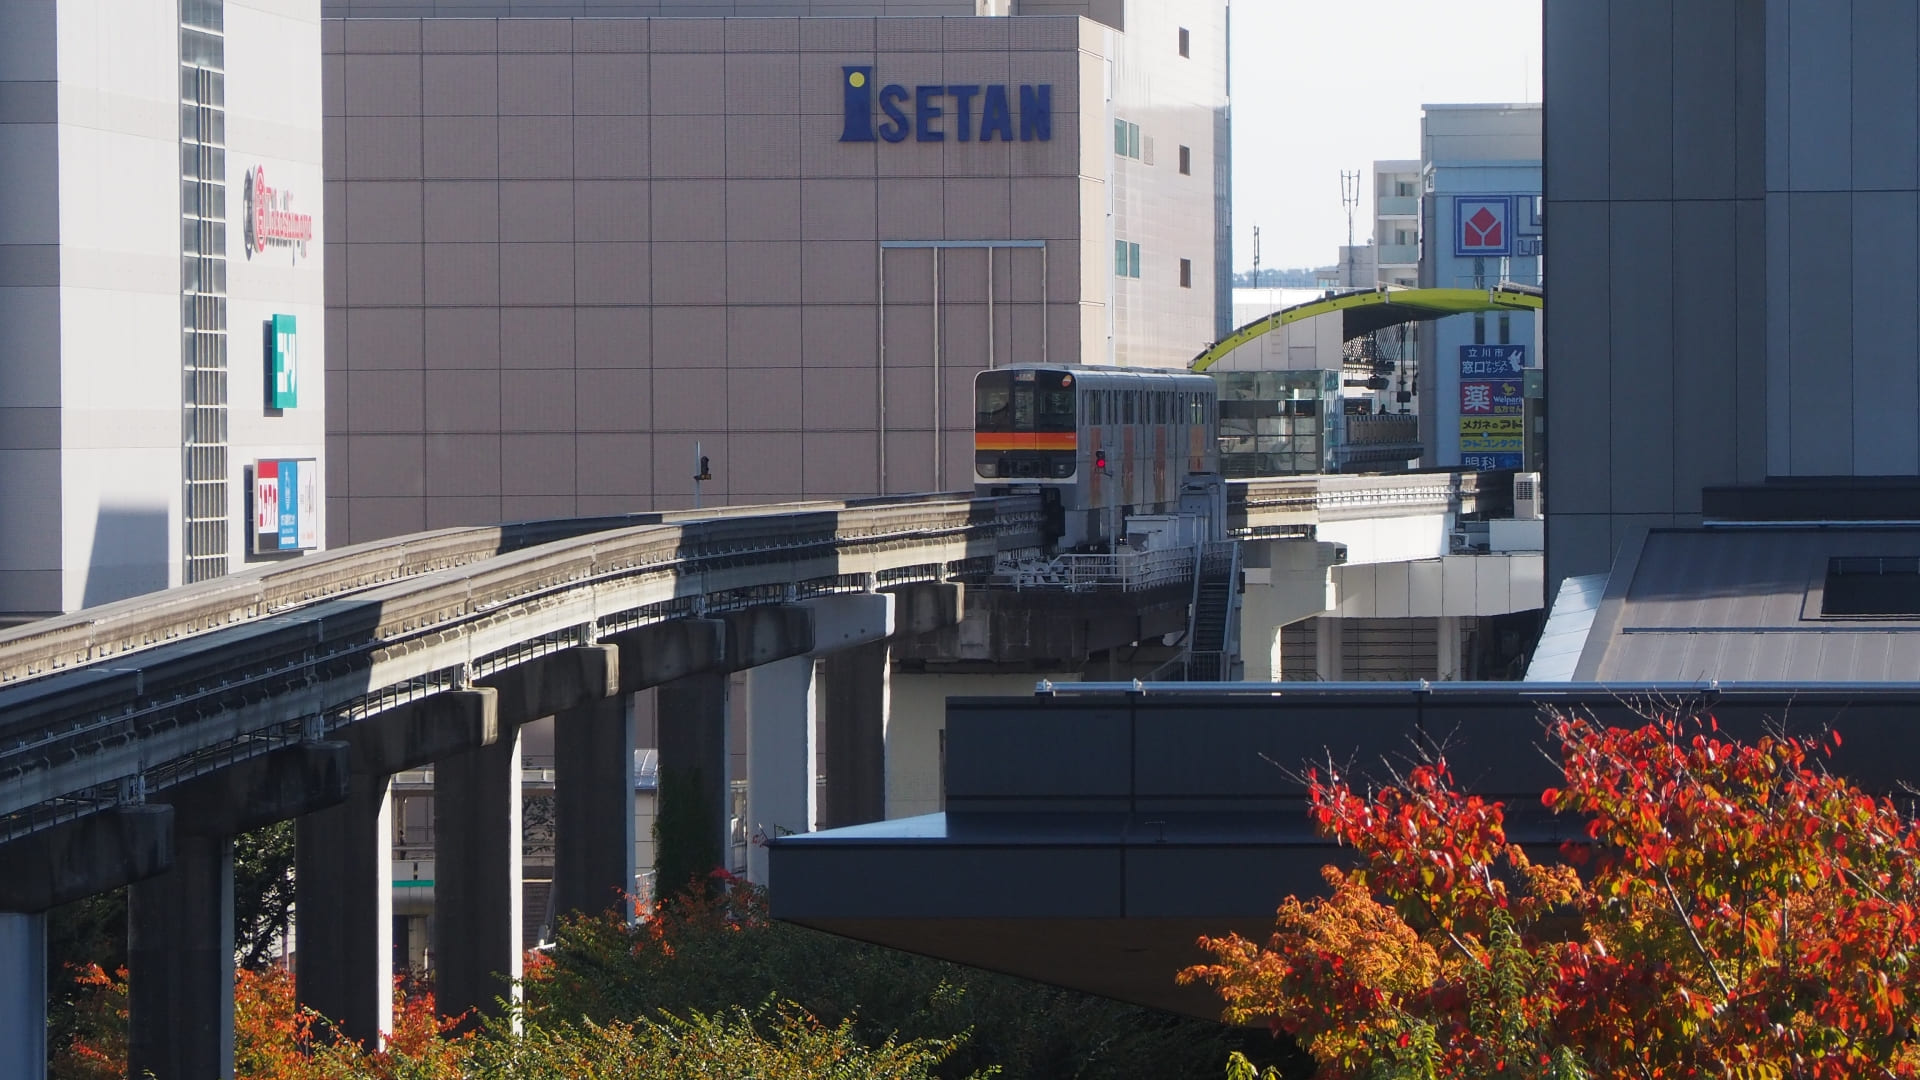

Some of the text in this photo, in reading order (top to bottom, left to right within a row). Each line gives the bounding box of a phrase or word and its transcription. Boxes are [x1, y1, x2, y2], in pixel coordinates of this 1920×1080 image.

[838, 66, 1052, 143] ISETAN
[1467, 348, 1504, 358] 立川市
[1462, 361, 1485, 374] 窓口
[1464, 384, 1490, 411] 薬
